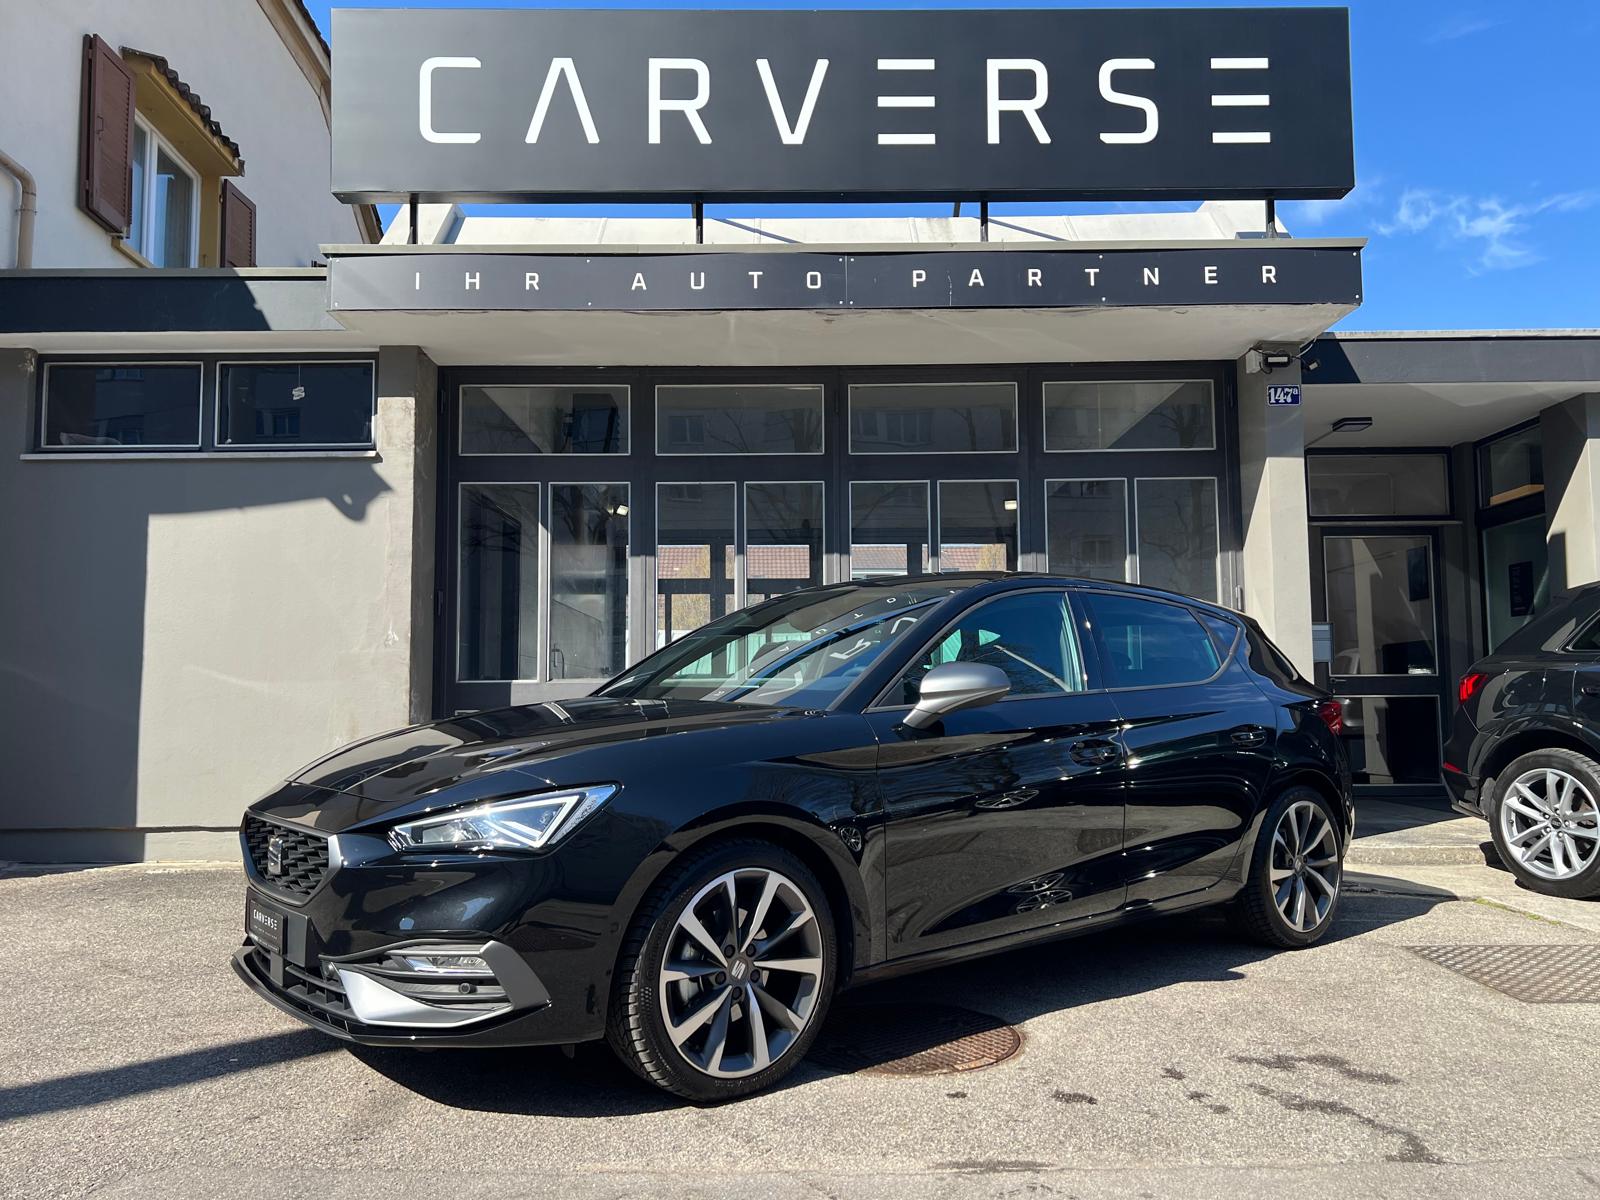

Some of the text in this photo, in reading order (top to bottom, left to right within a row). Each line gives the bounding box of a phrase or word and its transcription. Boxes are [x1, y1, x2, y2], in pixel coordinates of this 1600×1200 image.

[419, 57, 1270, 144] CARVERSE
[414, 265, 1276, 291] IHR AUTO PARTNER
[253, 909, 278, 930] CARVERSE
